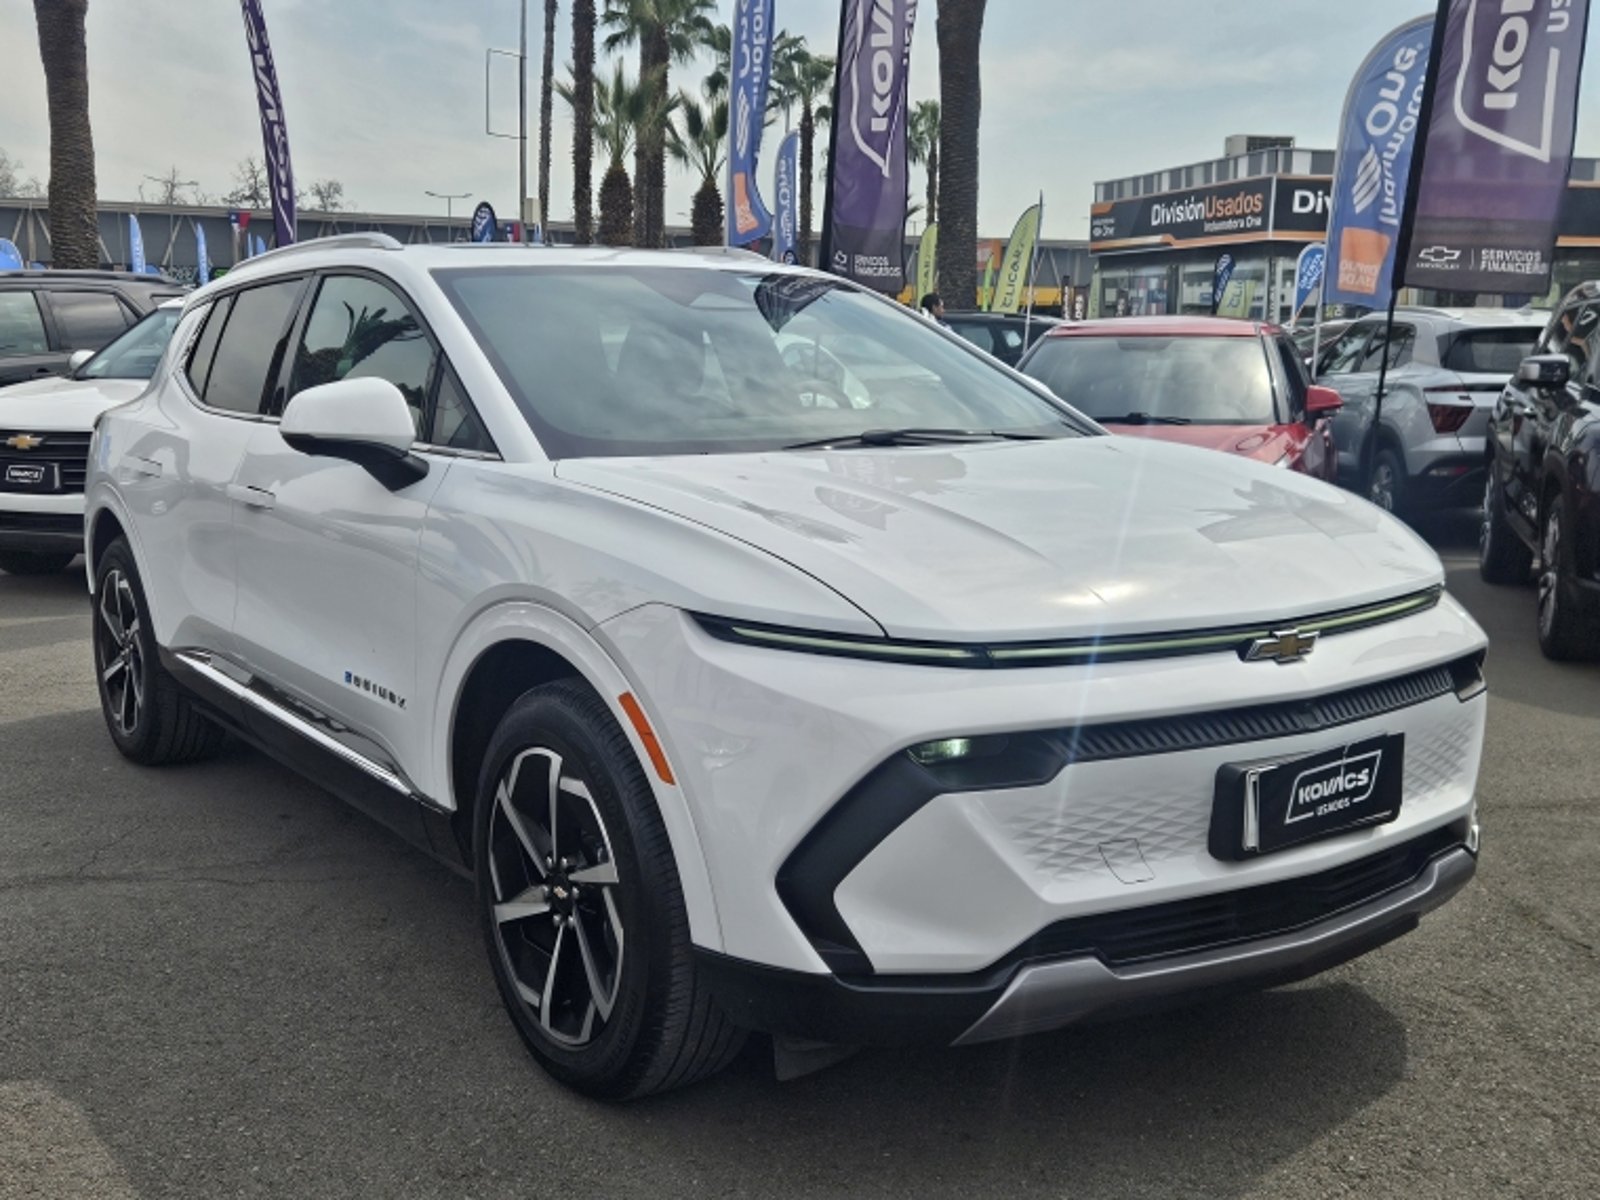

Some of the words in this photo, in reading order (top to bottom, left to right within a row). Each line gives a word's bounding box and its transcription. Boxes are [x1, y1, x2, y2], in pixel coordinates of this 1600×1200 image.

[1480, 248, 1542, 263] SERVICIOS
[1298, 768, 1371, 805] KOVACS
[1316, 796, 1351, 816] USADOS
